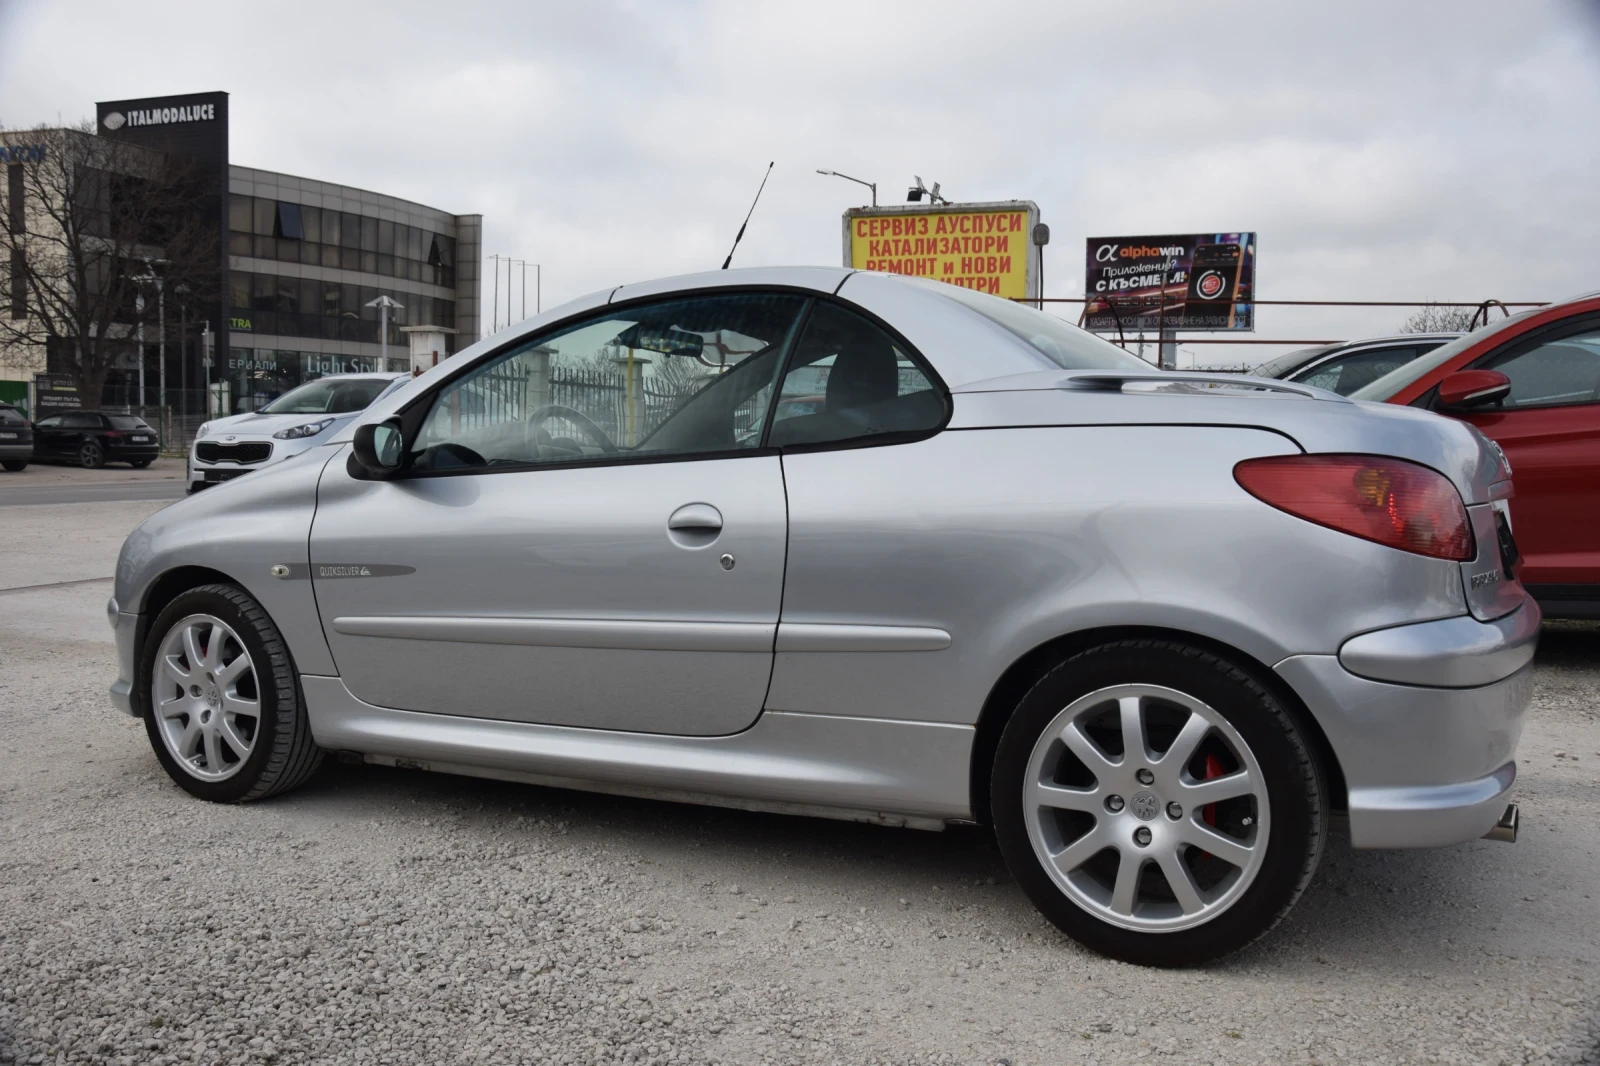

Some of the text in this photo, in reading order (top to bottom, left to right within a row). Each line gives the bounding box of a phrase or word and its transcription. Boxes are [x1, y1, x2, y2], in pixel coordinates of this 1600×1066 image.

[127, 104, 215, 127] ITALMODALUCE
[857, 213, 1022, 238] СЕРВИЗ АУСПУСИ
[869, 235, 1009, 257] КАТАЛИЗАТОРИ
[1120, 244, 1185, 260] alphawin
[866, 257, 938, 276] РЕМОНТ
[961, 255, 1011, 274] НОВИ
[931, 276, 1000, 295] ЛТРИ
[229, 317, 252, 328] TRA
[307, 355, 347, 376] Light
[320, 566, 360, 577] QUIKSILVER
